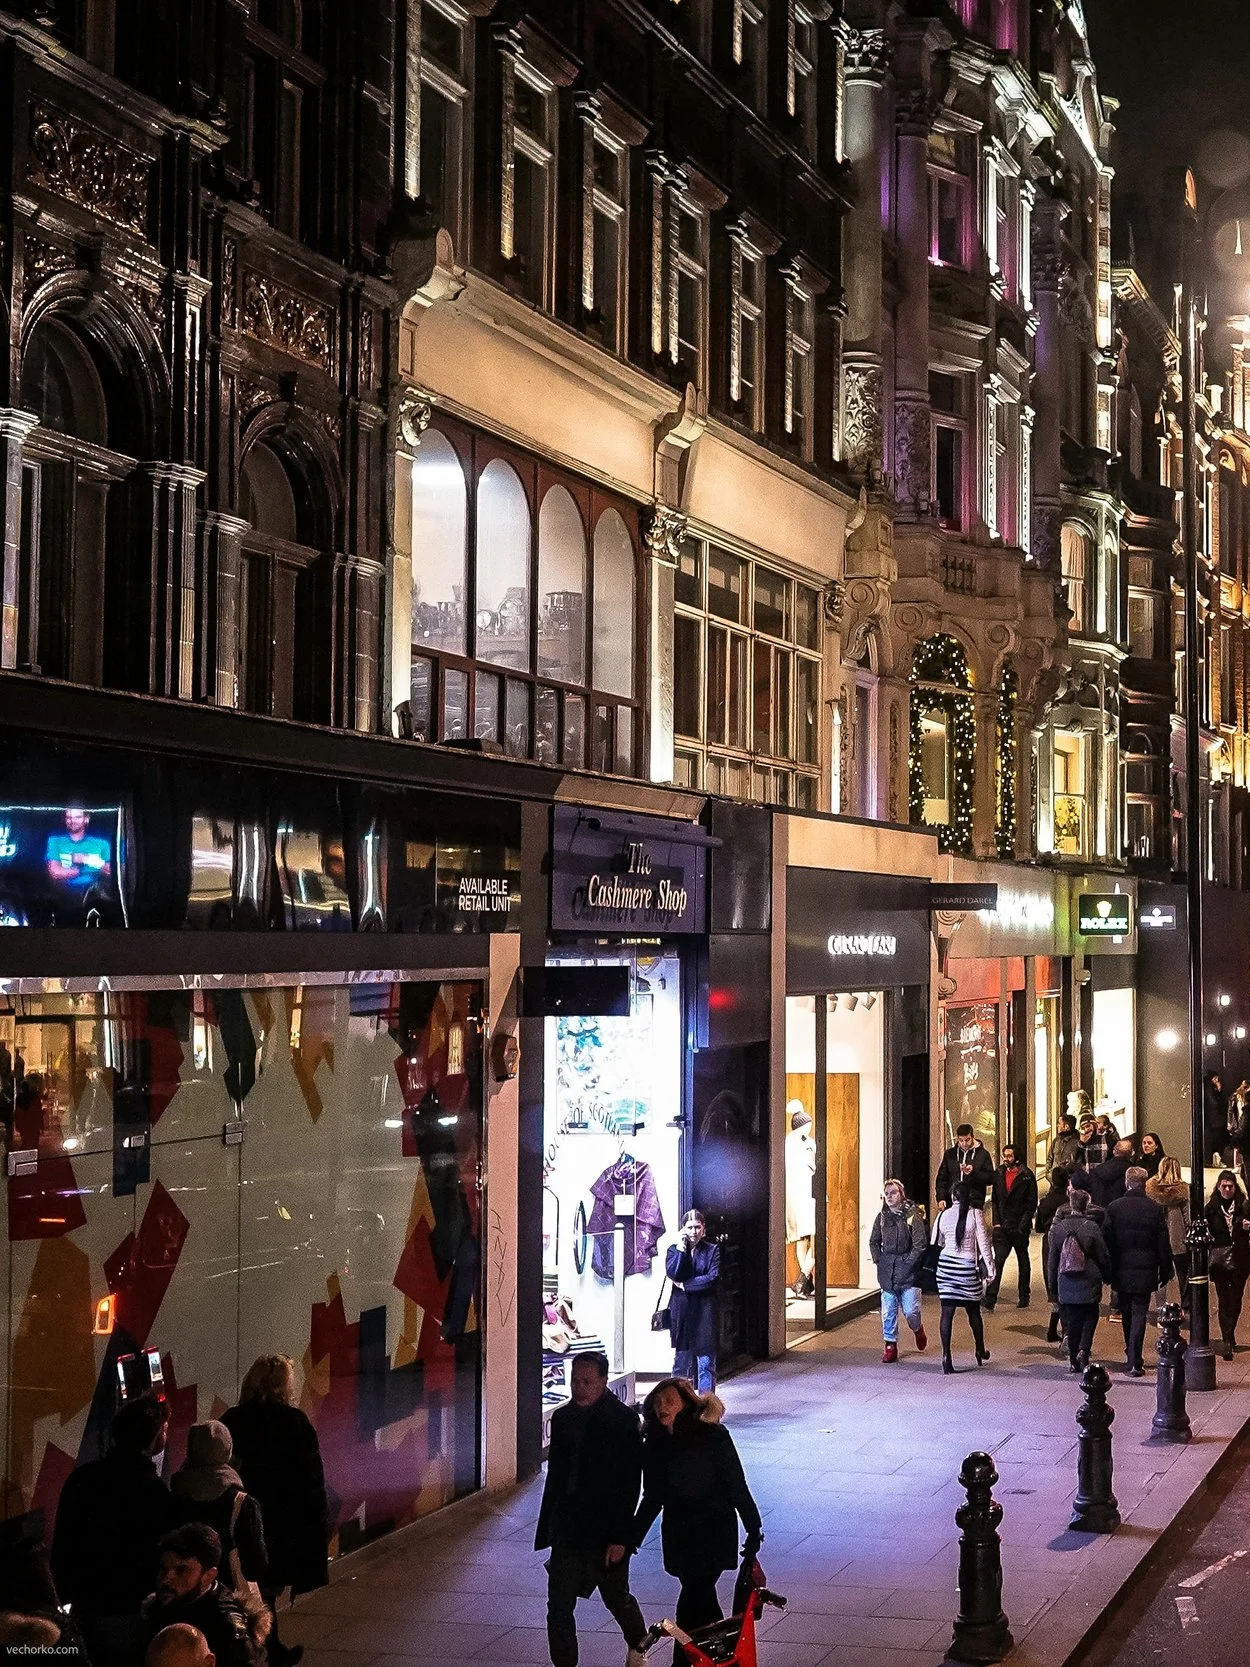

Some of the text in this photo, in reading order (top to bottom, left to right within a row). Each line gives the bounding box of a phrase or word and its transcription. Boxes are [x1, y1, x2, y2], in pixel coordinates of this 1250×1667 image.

[628, 843, 652, 875] The
[458, 877, 508, 896] AVAILABLE
[588, 874, 688, 917] Cashmere Shop
[458, 895, 512, 912] RETAIL UNIT
[932, 897, 993, 905] GERARD DAREL
[1080, 917, 1128, 929] ROLEX
